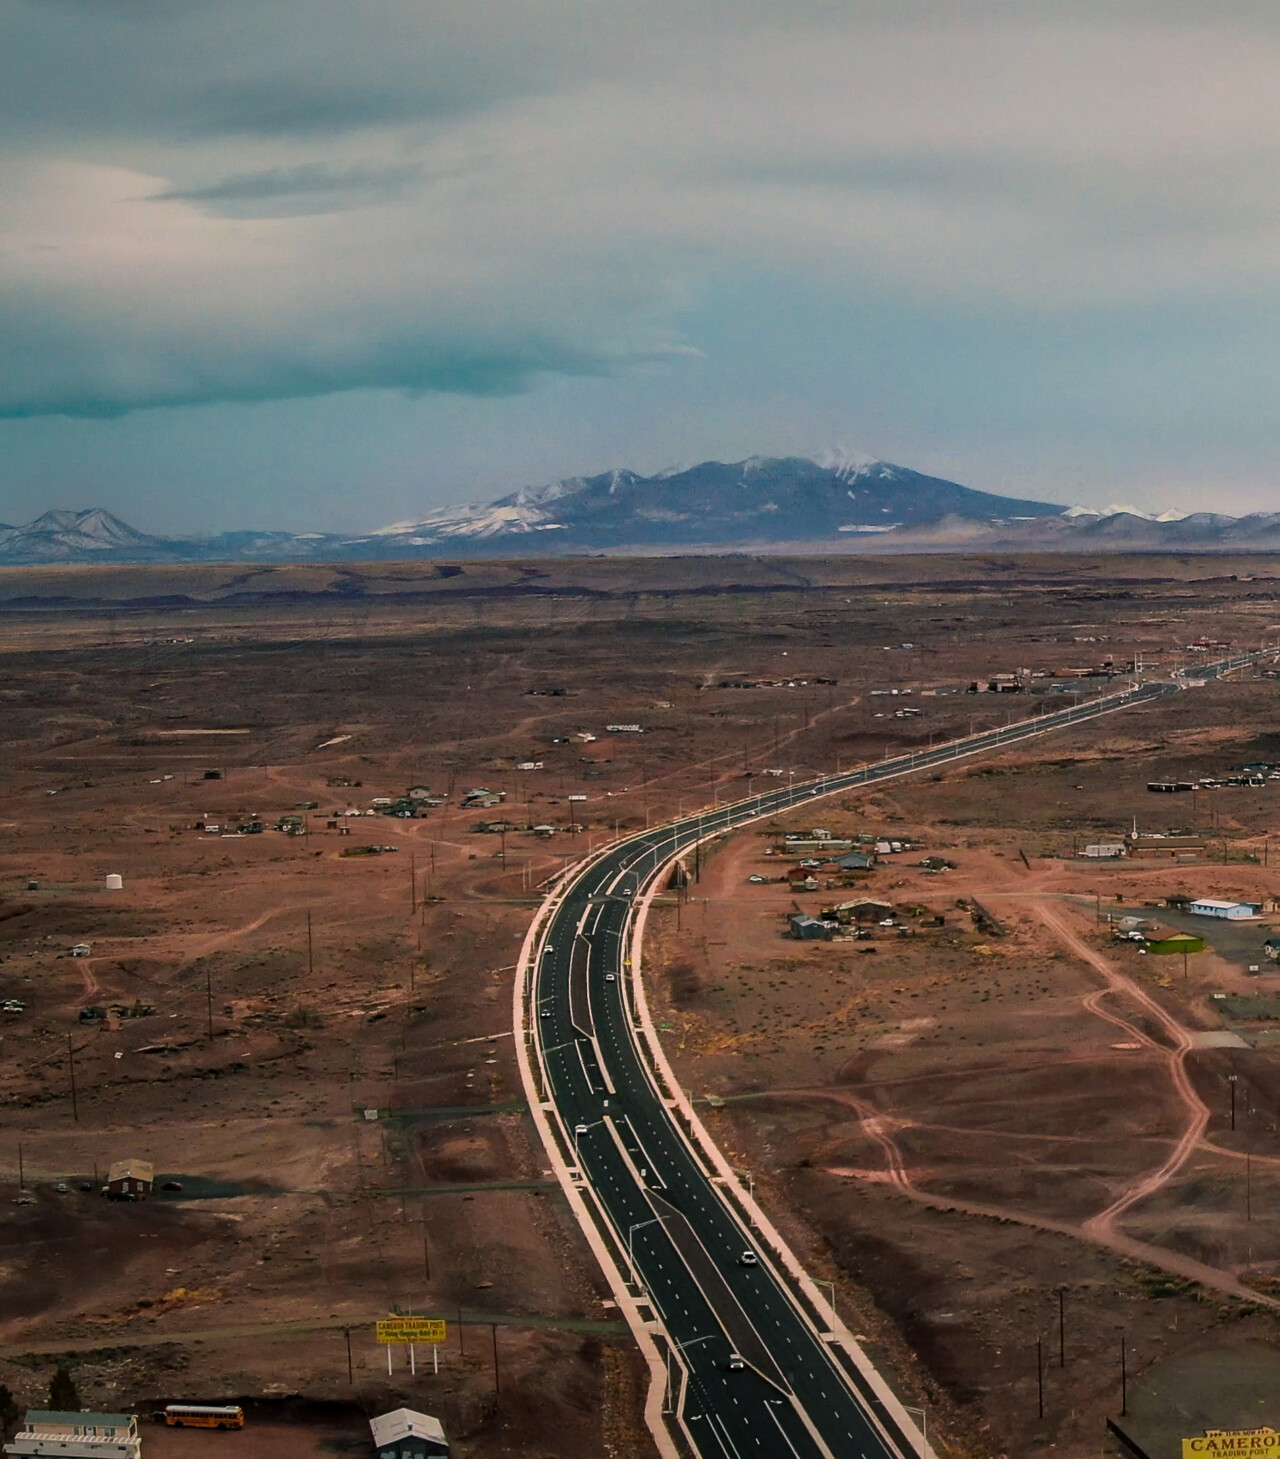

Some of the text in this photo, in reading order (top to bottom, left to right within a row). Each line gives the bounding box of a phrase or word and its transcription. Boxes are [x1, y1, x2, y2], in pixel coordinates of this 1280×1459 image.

[379, 1321, 404, 1329] CAMERON
[1212, 1448, 1270, 1459] TRADING POST
